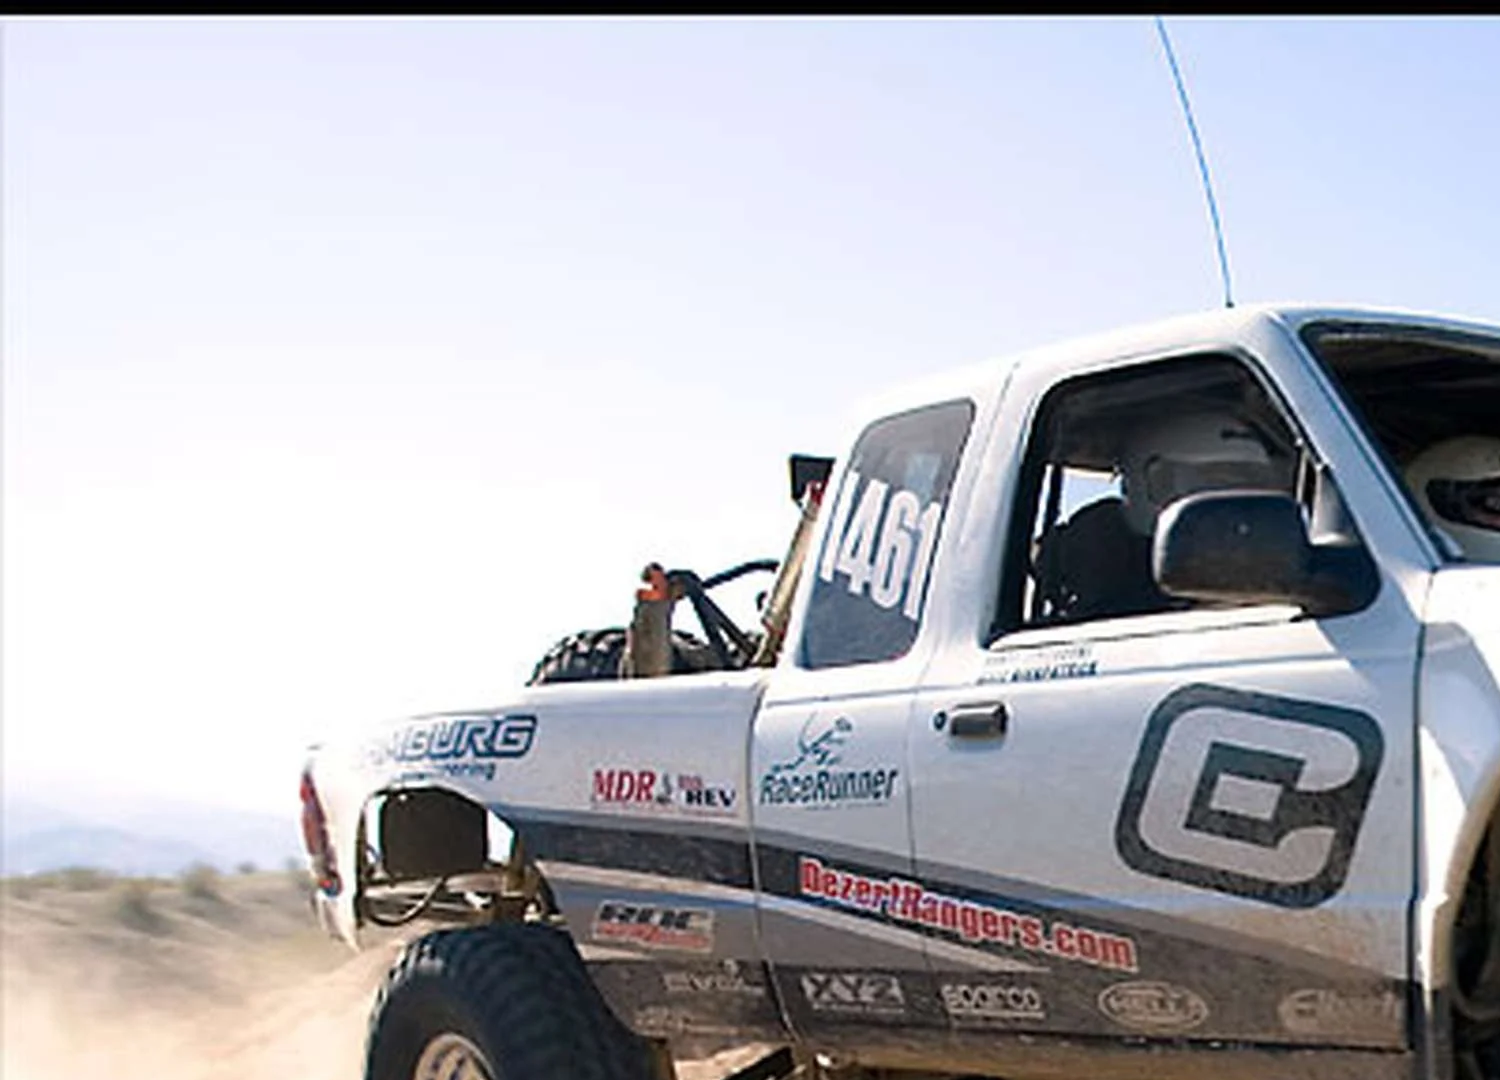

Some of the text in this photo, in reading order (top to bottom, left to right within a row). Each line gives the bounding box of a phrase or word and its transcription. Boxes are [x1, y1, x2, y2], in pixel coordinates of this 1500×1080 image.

[820, 471, 943, 621] 1461
[368, 713, 539, 762] BURG
[592, 769, 656, 802] MDR
[759, 765, 899, 806] RaceRunner
[801, 860, 1136, 972] DezertRangers.com
